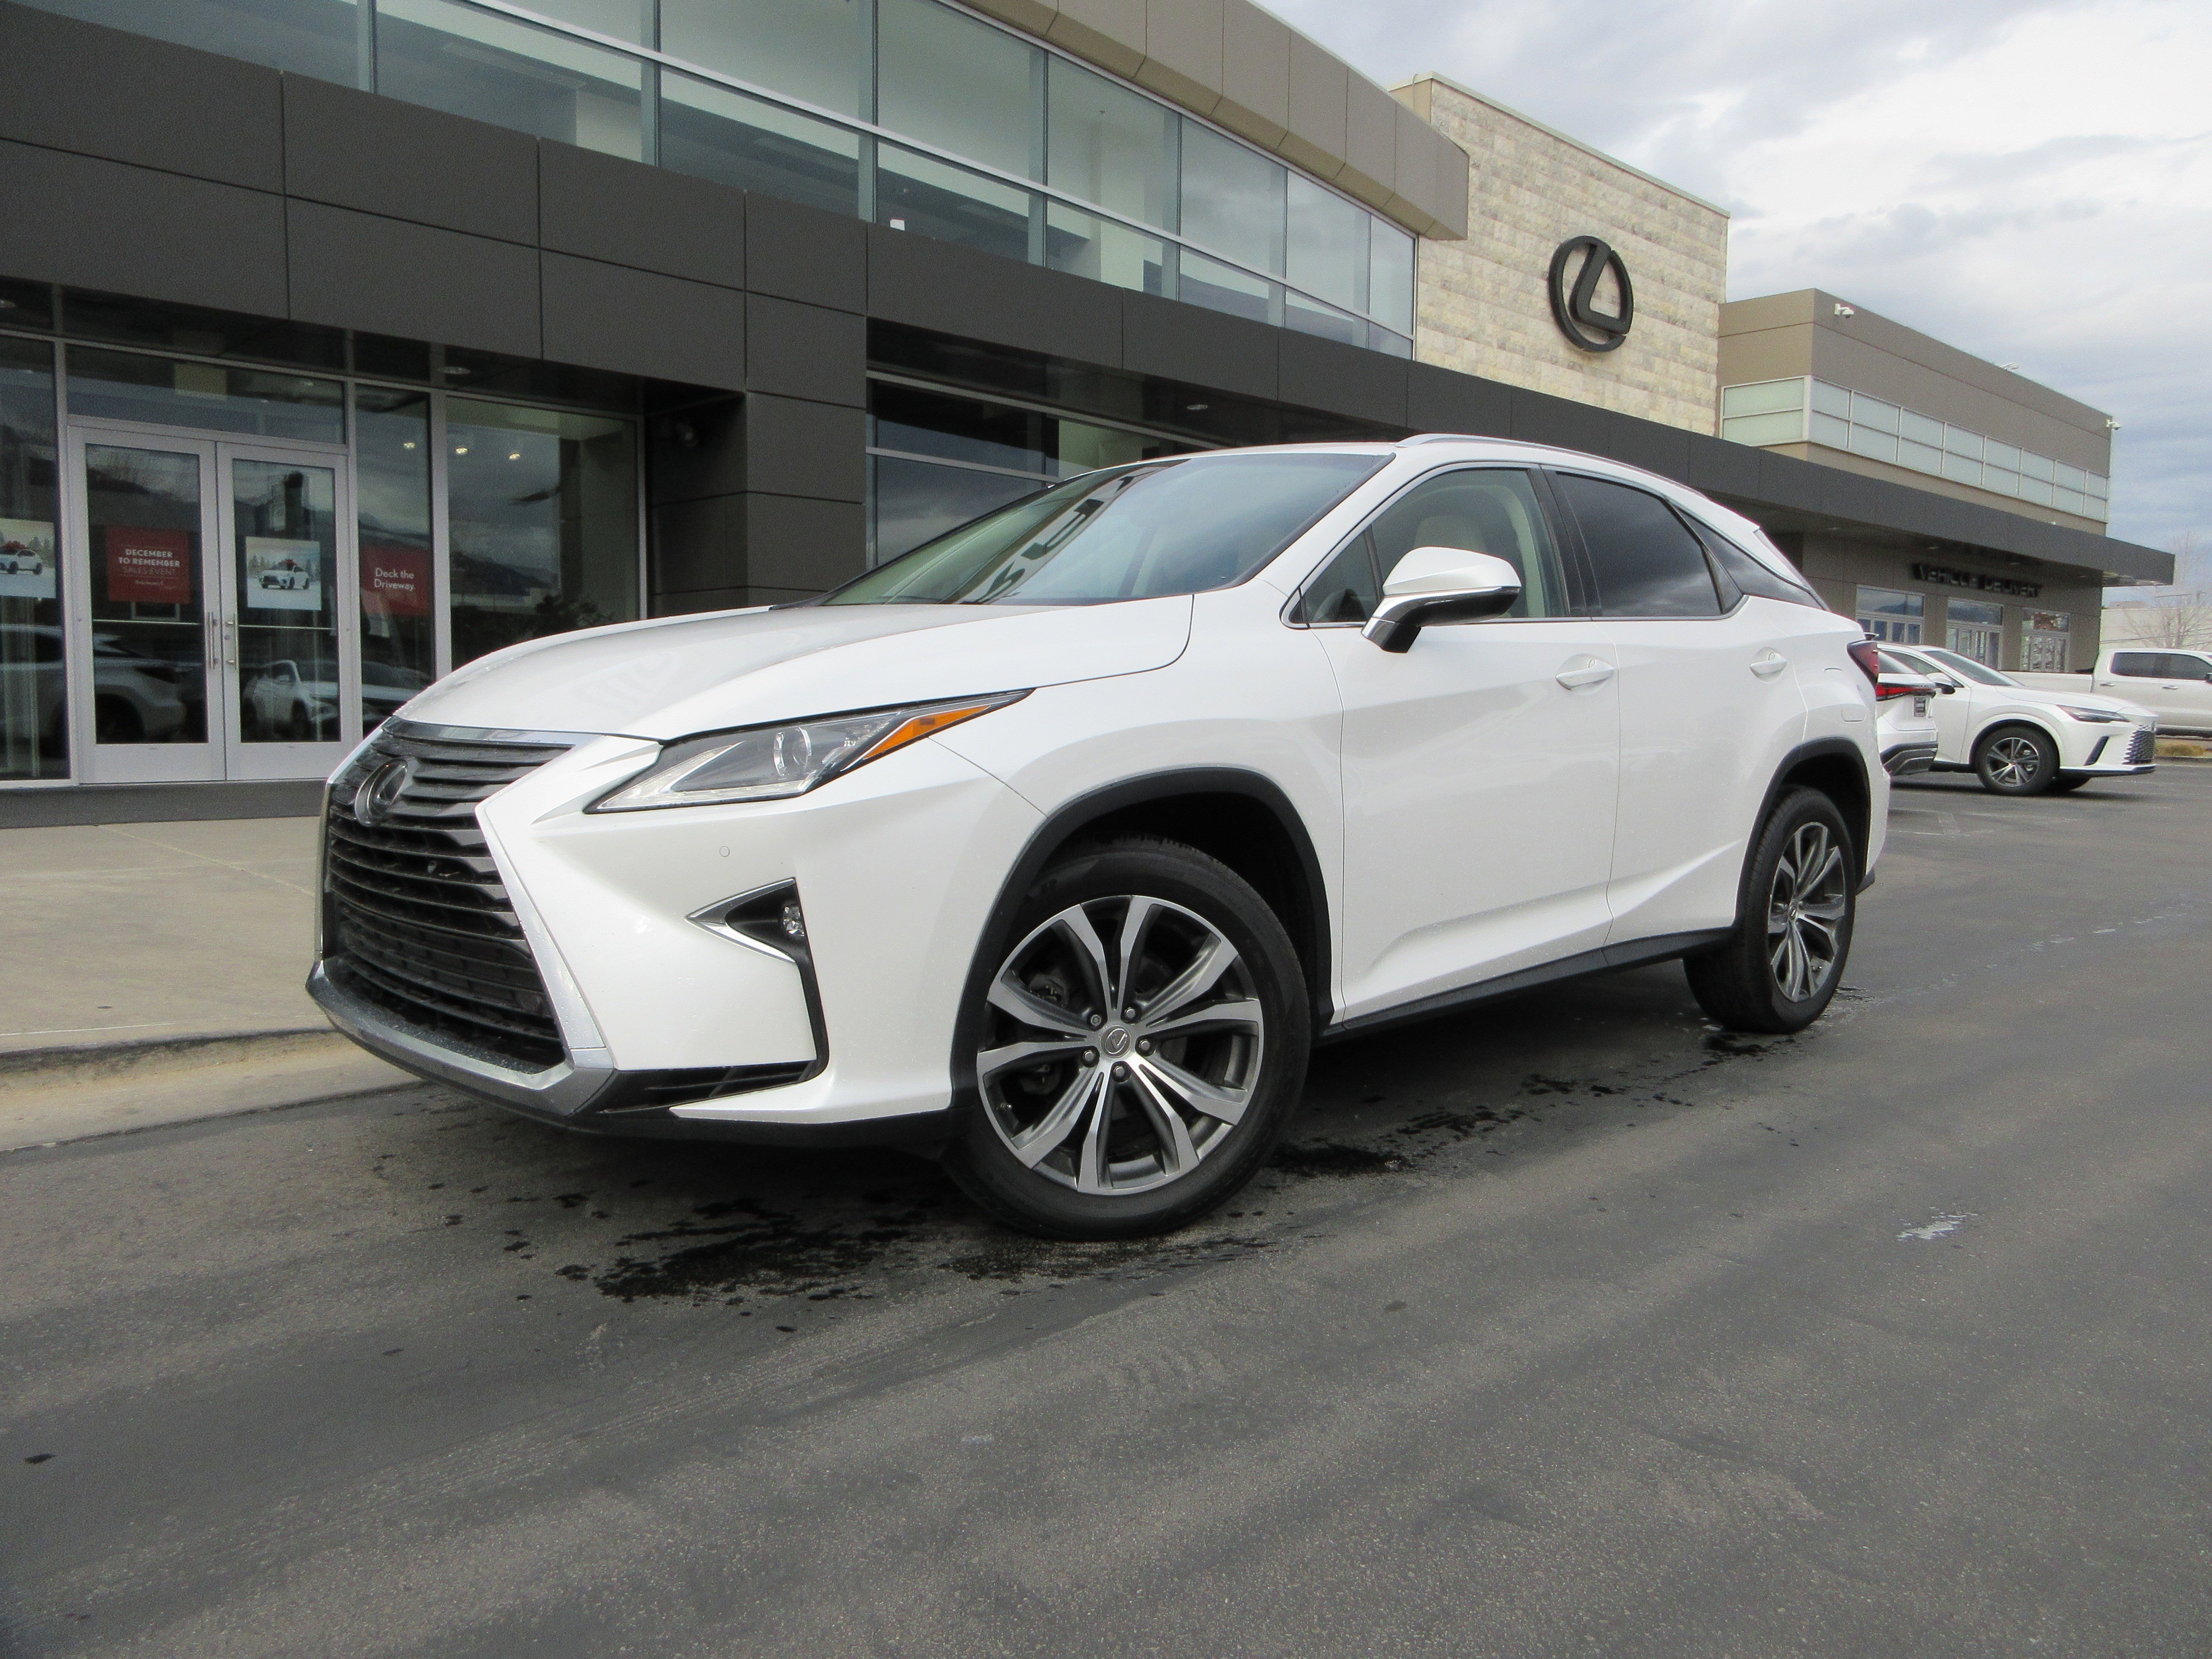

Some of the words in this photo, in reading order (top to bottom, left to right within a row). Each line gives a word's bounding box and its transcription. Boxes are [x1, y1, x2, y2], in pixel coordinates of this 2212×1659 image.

[125, 549, 173, 558] DECEMBER
[132, 558, 180, 567] REMEMBER
[375, 568, 399, 578] Deck
[400, 570, 414, 579] the
